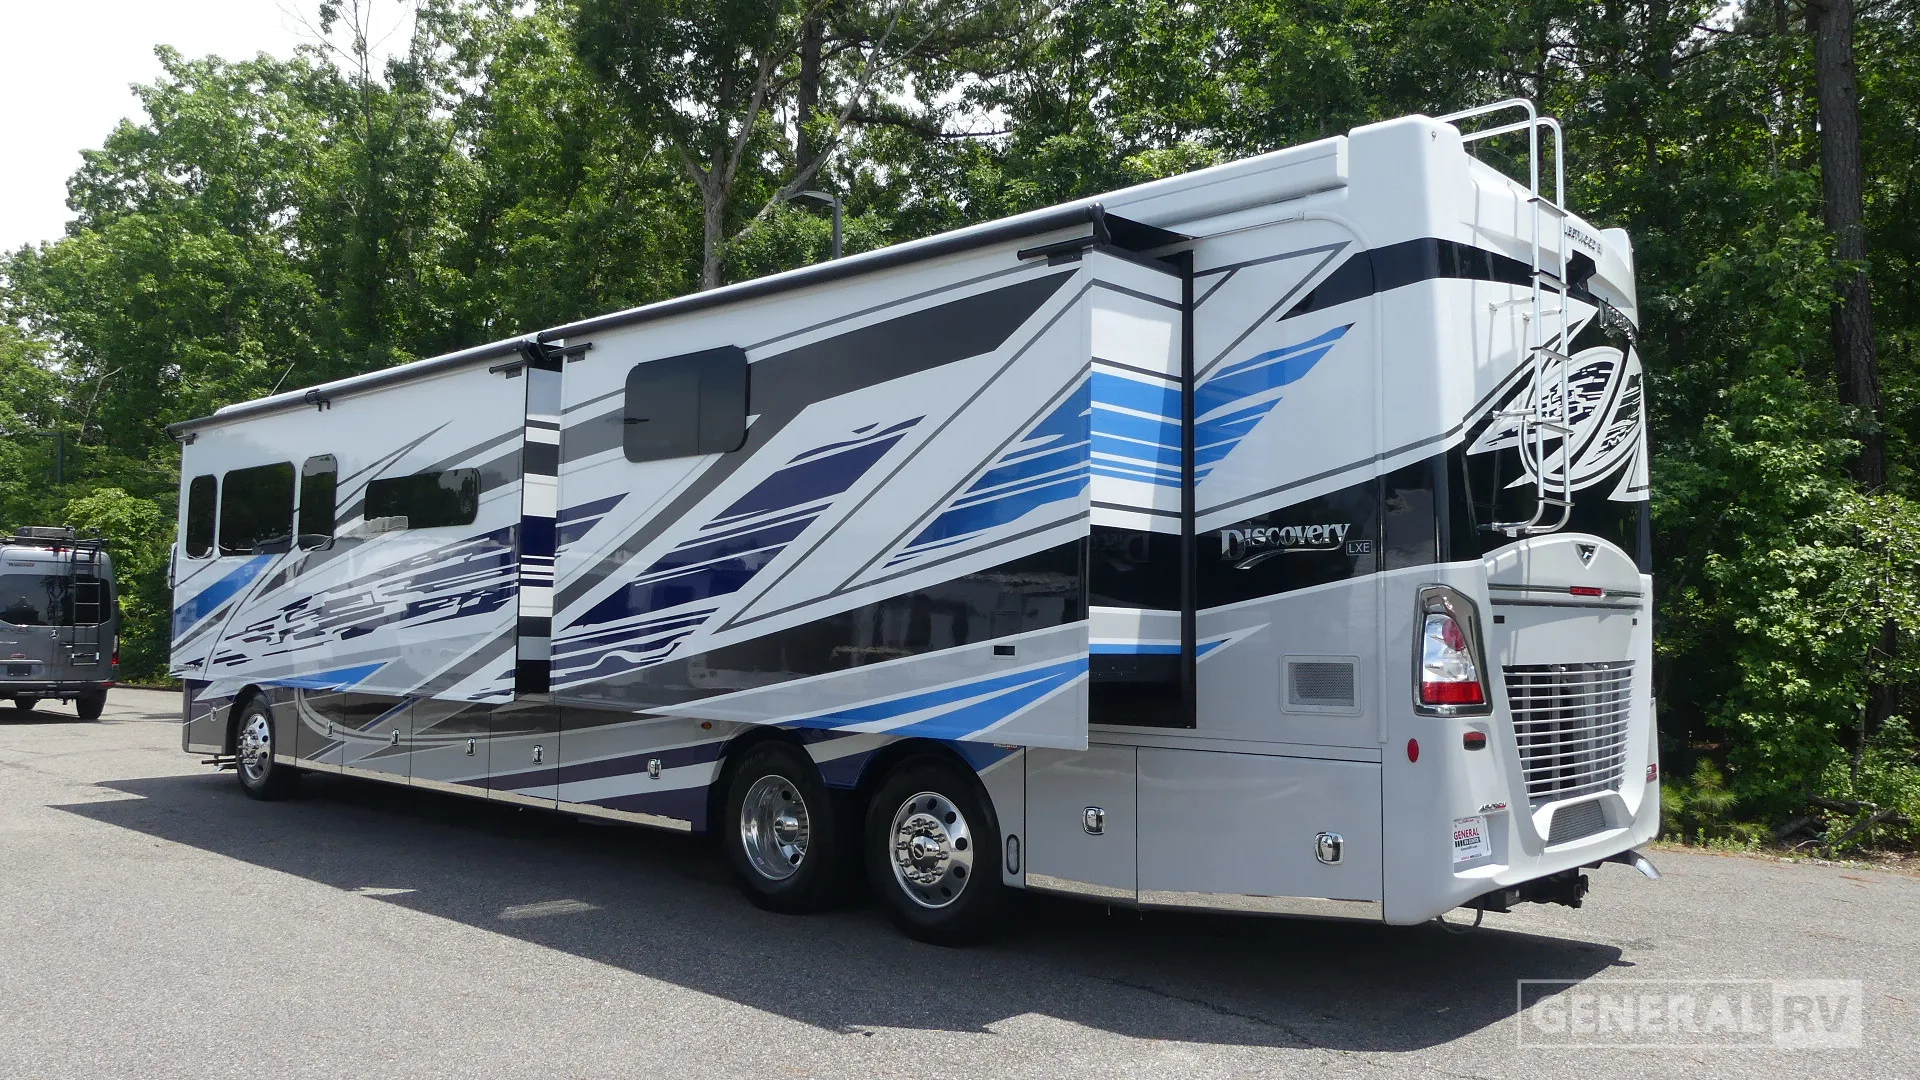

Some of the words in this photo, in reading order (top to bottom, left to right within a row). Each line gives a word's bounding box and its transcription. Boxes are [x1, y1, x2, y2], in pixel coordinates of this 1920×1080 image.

[1220, 523, 1351, 560] Discovery
[1349, 541, 1371, 554] LXE
[1453, 828, 1480, 841] GENERAL
